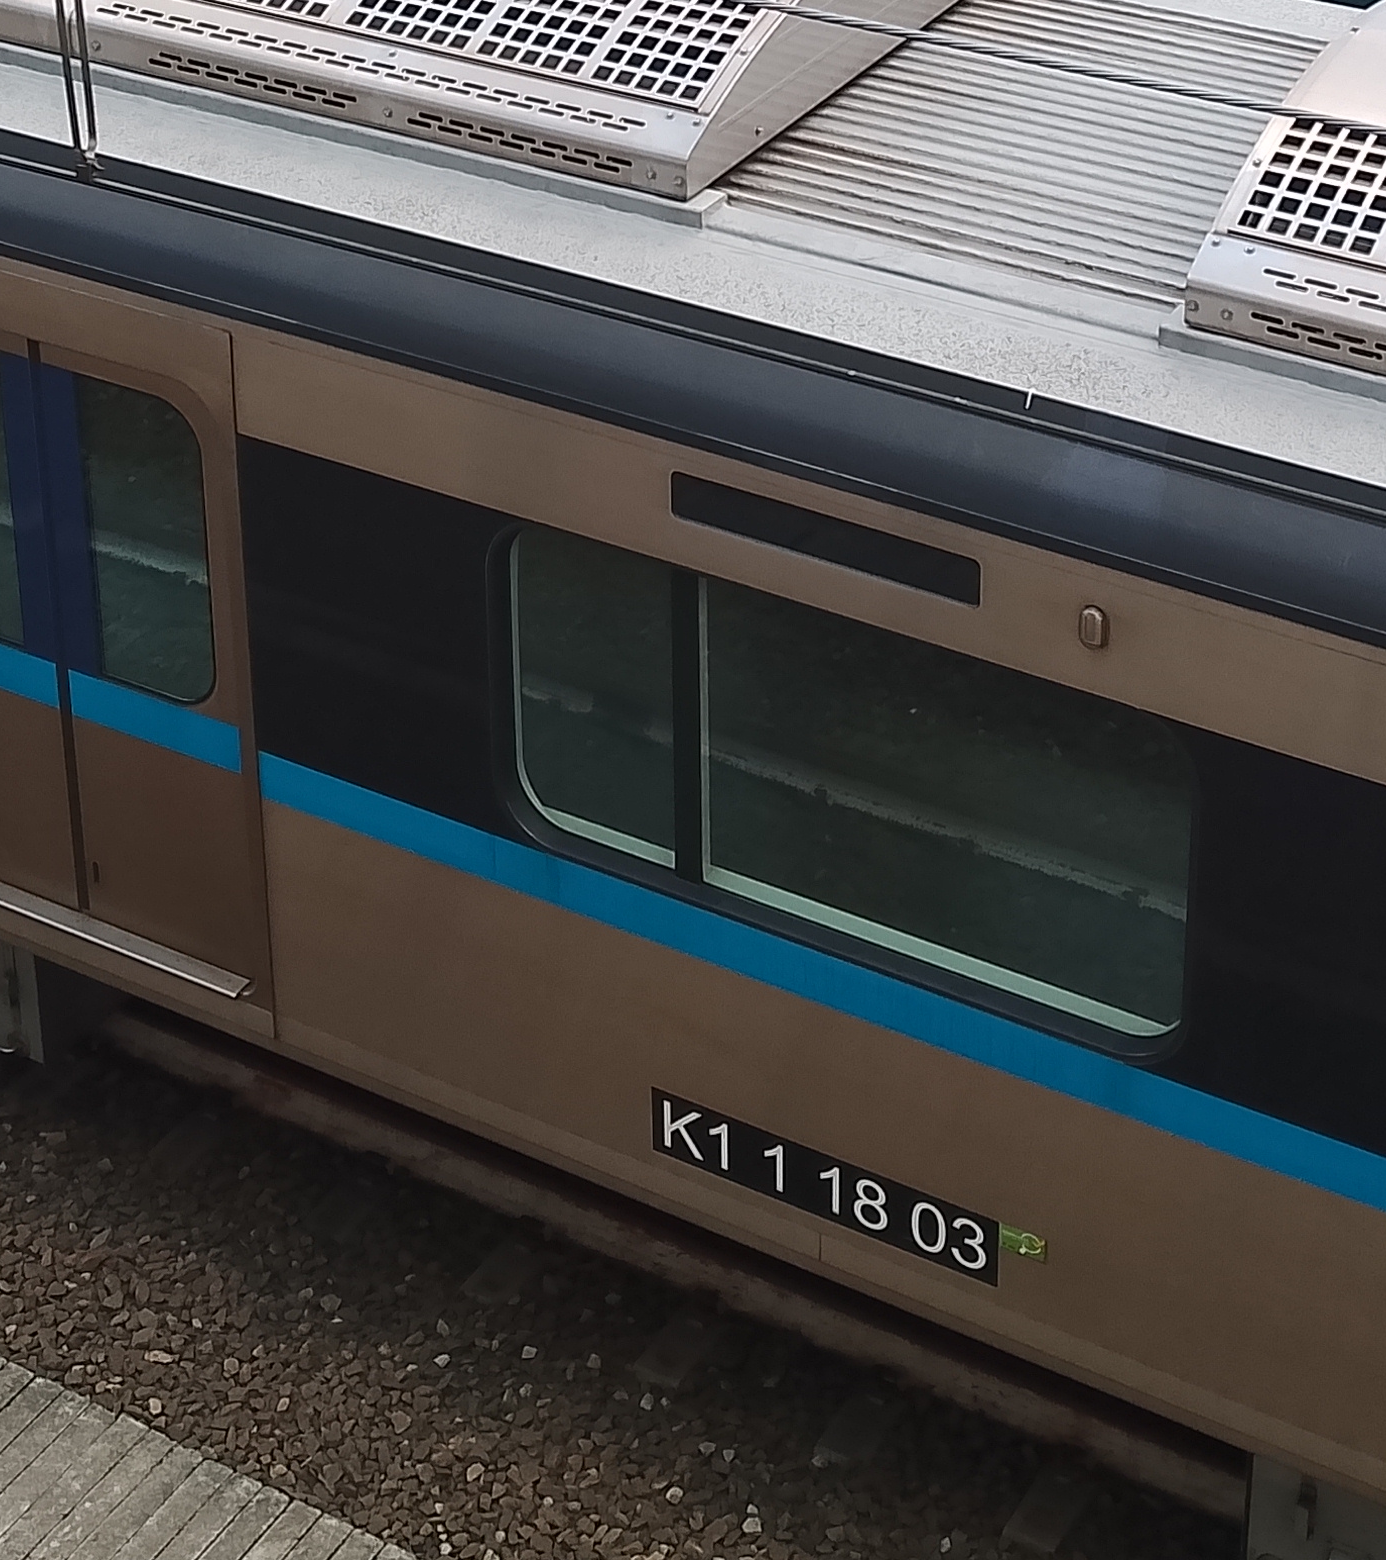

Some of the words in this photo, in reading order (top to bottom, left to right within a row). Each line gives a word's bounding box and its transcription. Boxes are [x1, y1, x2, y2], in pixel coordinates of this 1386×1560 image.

[662, 1099, 729, 1171] K1
[763, 1144, 784, 1193] 1
[819, 1166, 889, 1231] 18
[911, 1201, 987, 1270] 03
